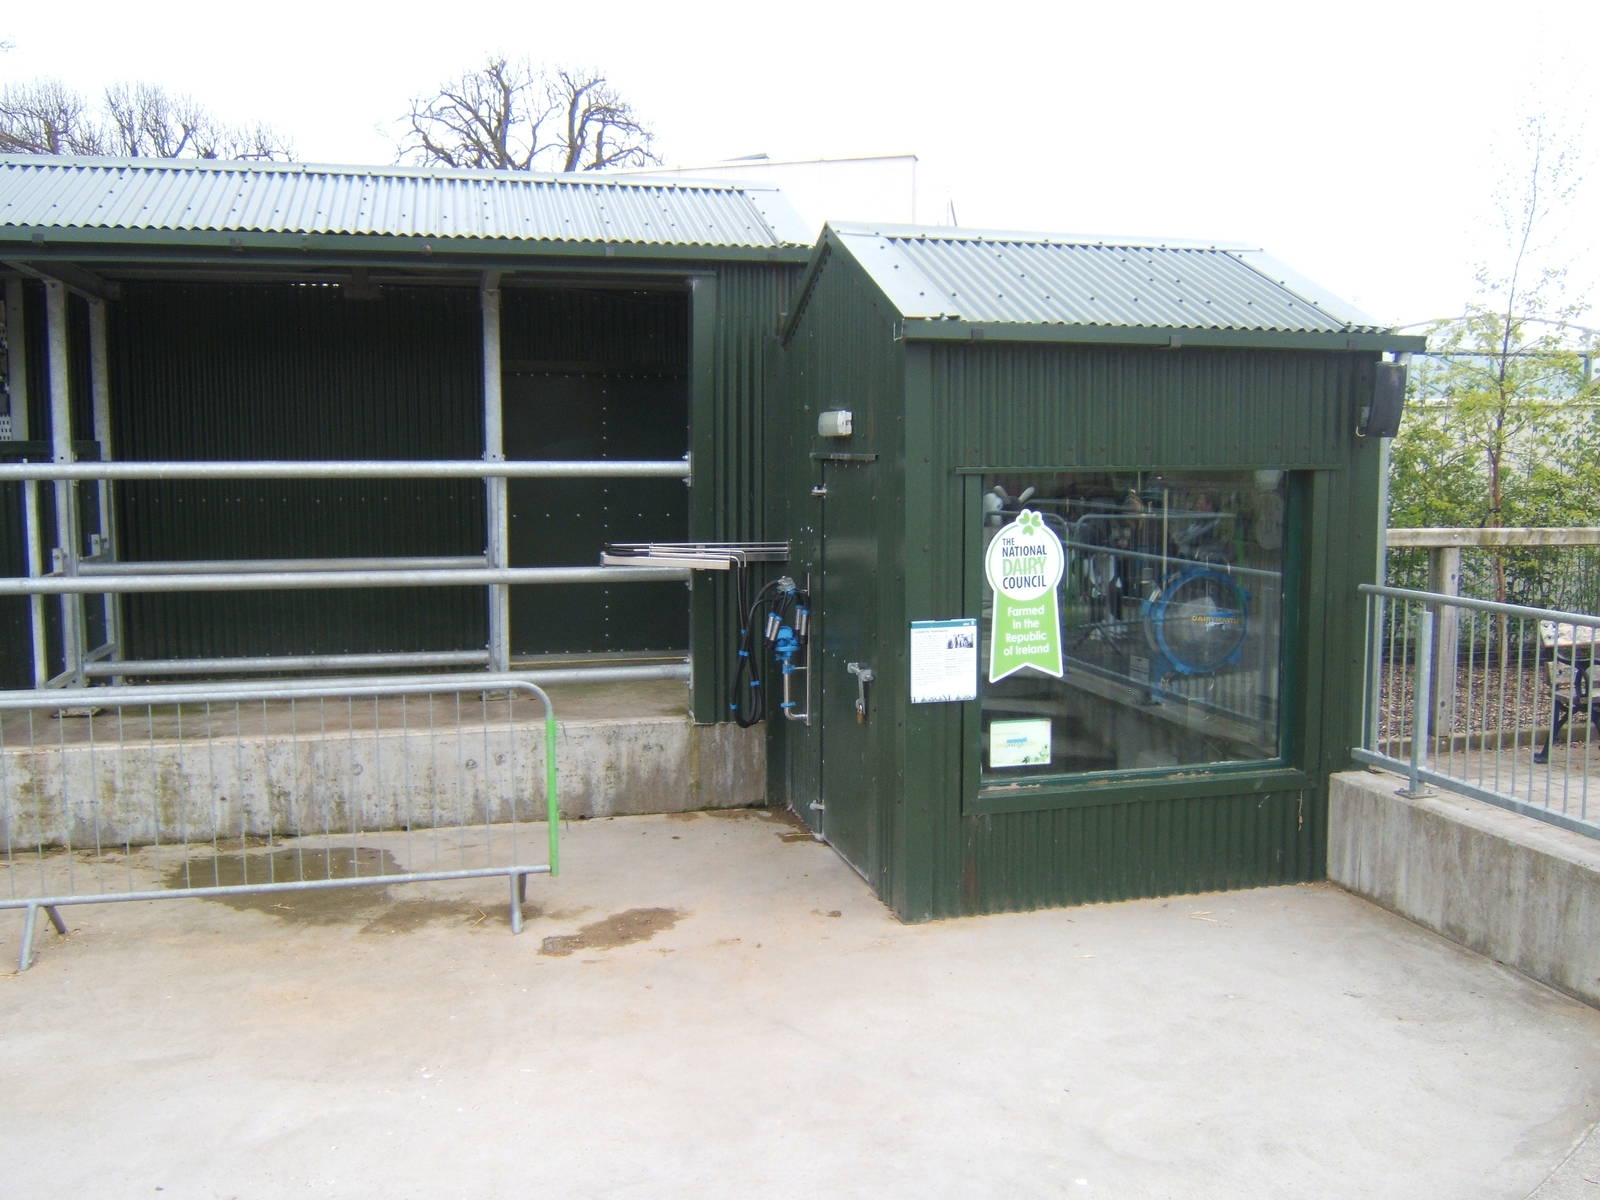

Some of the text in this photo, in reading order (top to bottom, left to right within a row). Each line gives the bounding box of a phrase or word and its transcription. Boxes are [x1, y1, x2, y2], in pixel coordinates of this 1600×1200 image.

[1002, 538, 1015, 546] THE
[1002, 545, 1047, 557] NATIONAL
[1003, 557, 1047, 576] DAIRY
[1003, 575, 1047, 589] COUNCIL
[1007, 605, 1045, 617] Farmed
[1012, 618, 1040, 629] in the
[1005, 630, 1048, 644] Republic
[1003, 643, 1049, 656] of Ireland
